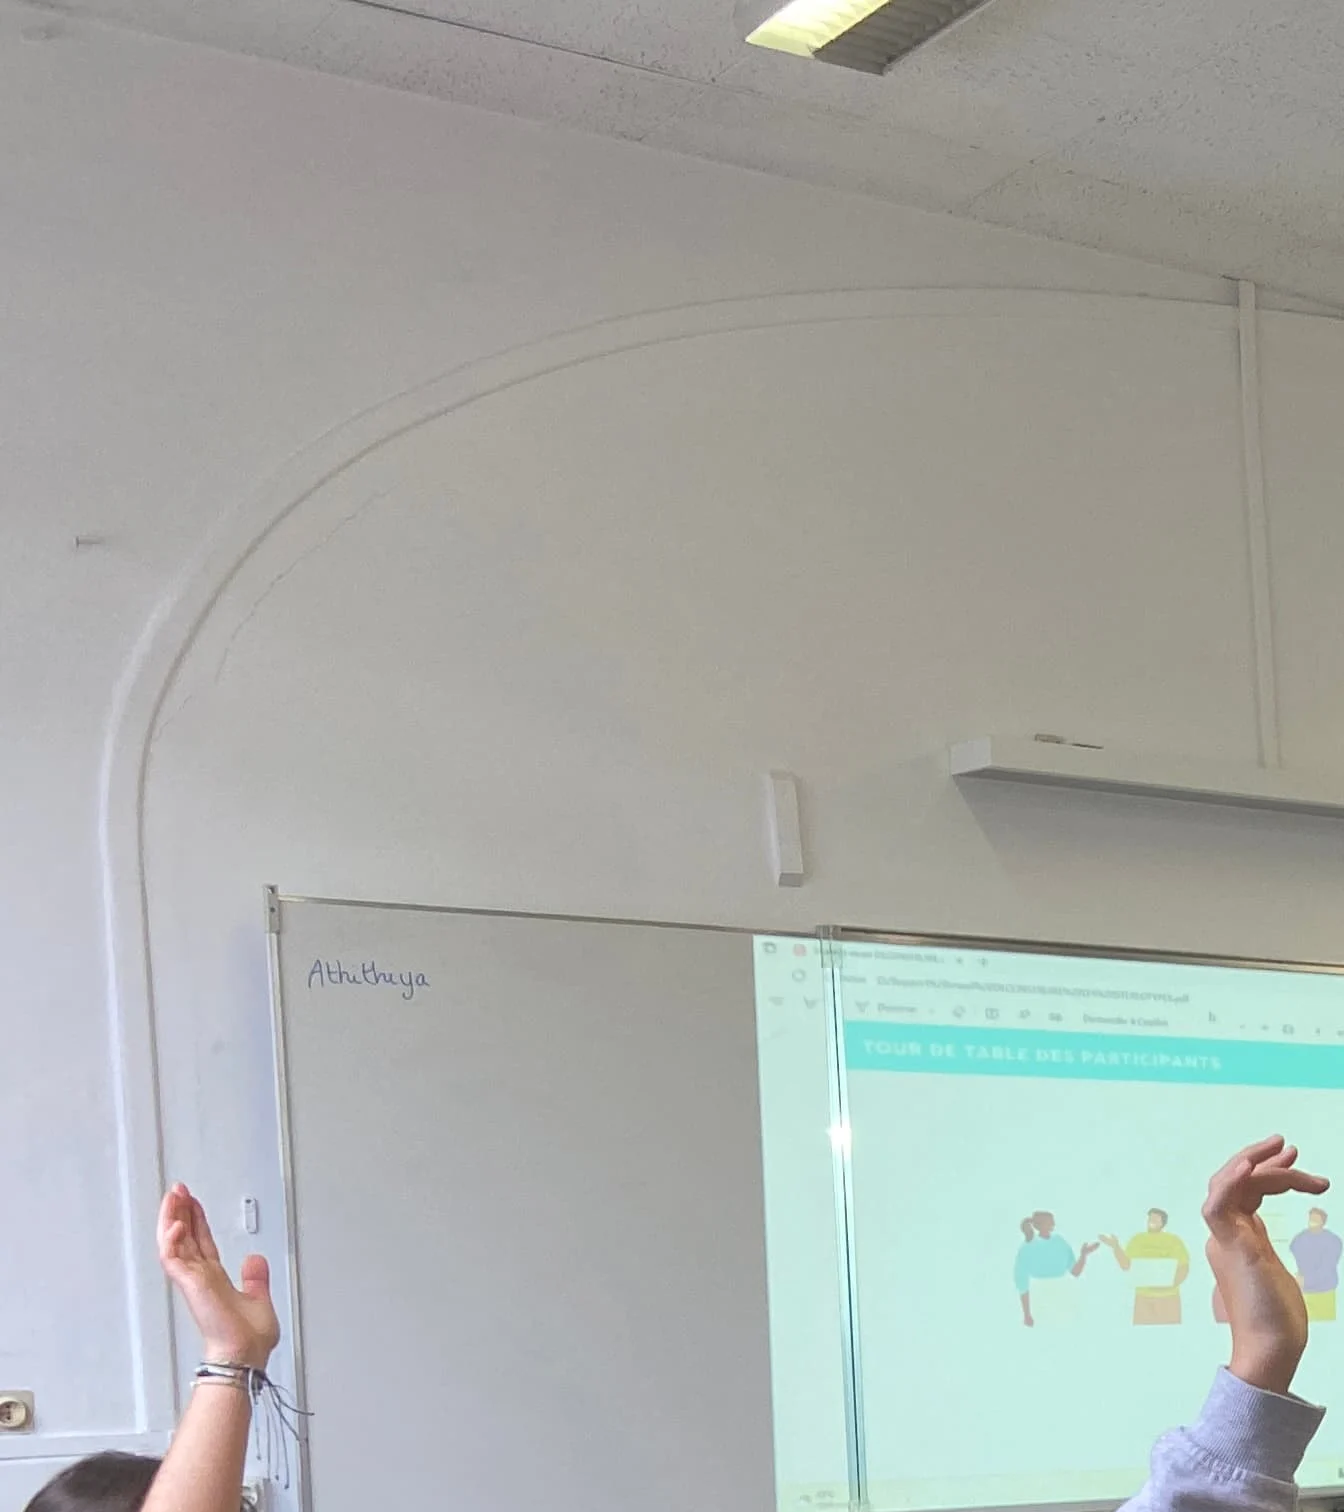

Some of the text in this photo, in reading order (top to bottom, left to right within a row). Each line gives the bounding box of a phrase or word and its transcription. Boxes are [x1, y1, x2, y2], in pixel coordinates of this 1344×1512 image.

[863, 1039, 1222, 1071] TOUR DE TABLE DES PARTICIPANTS
